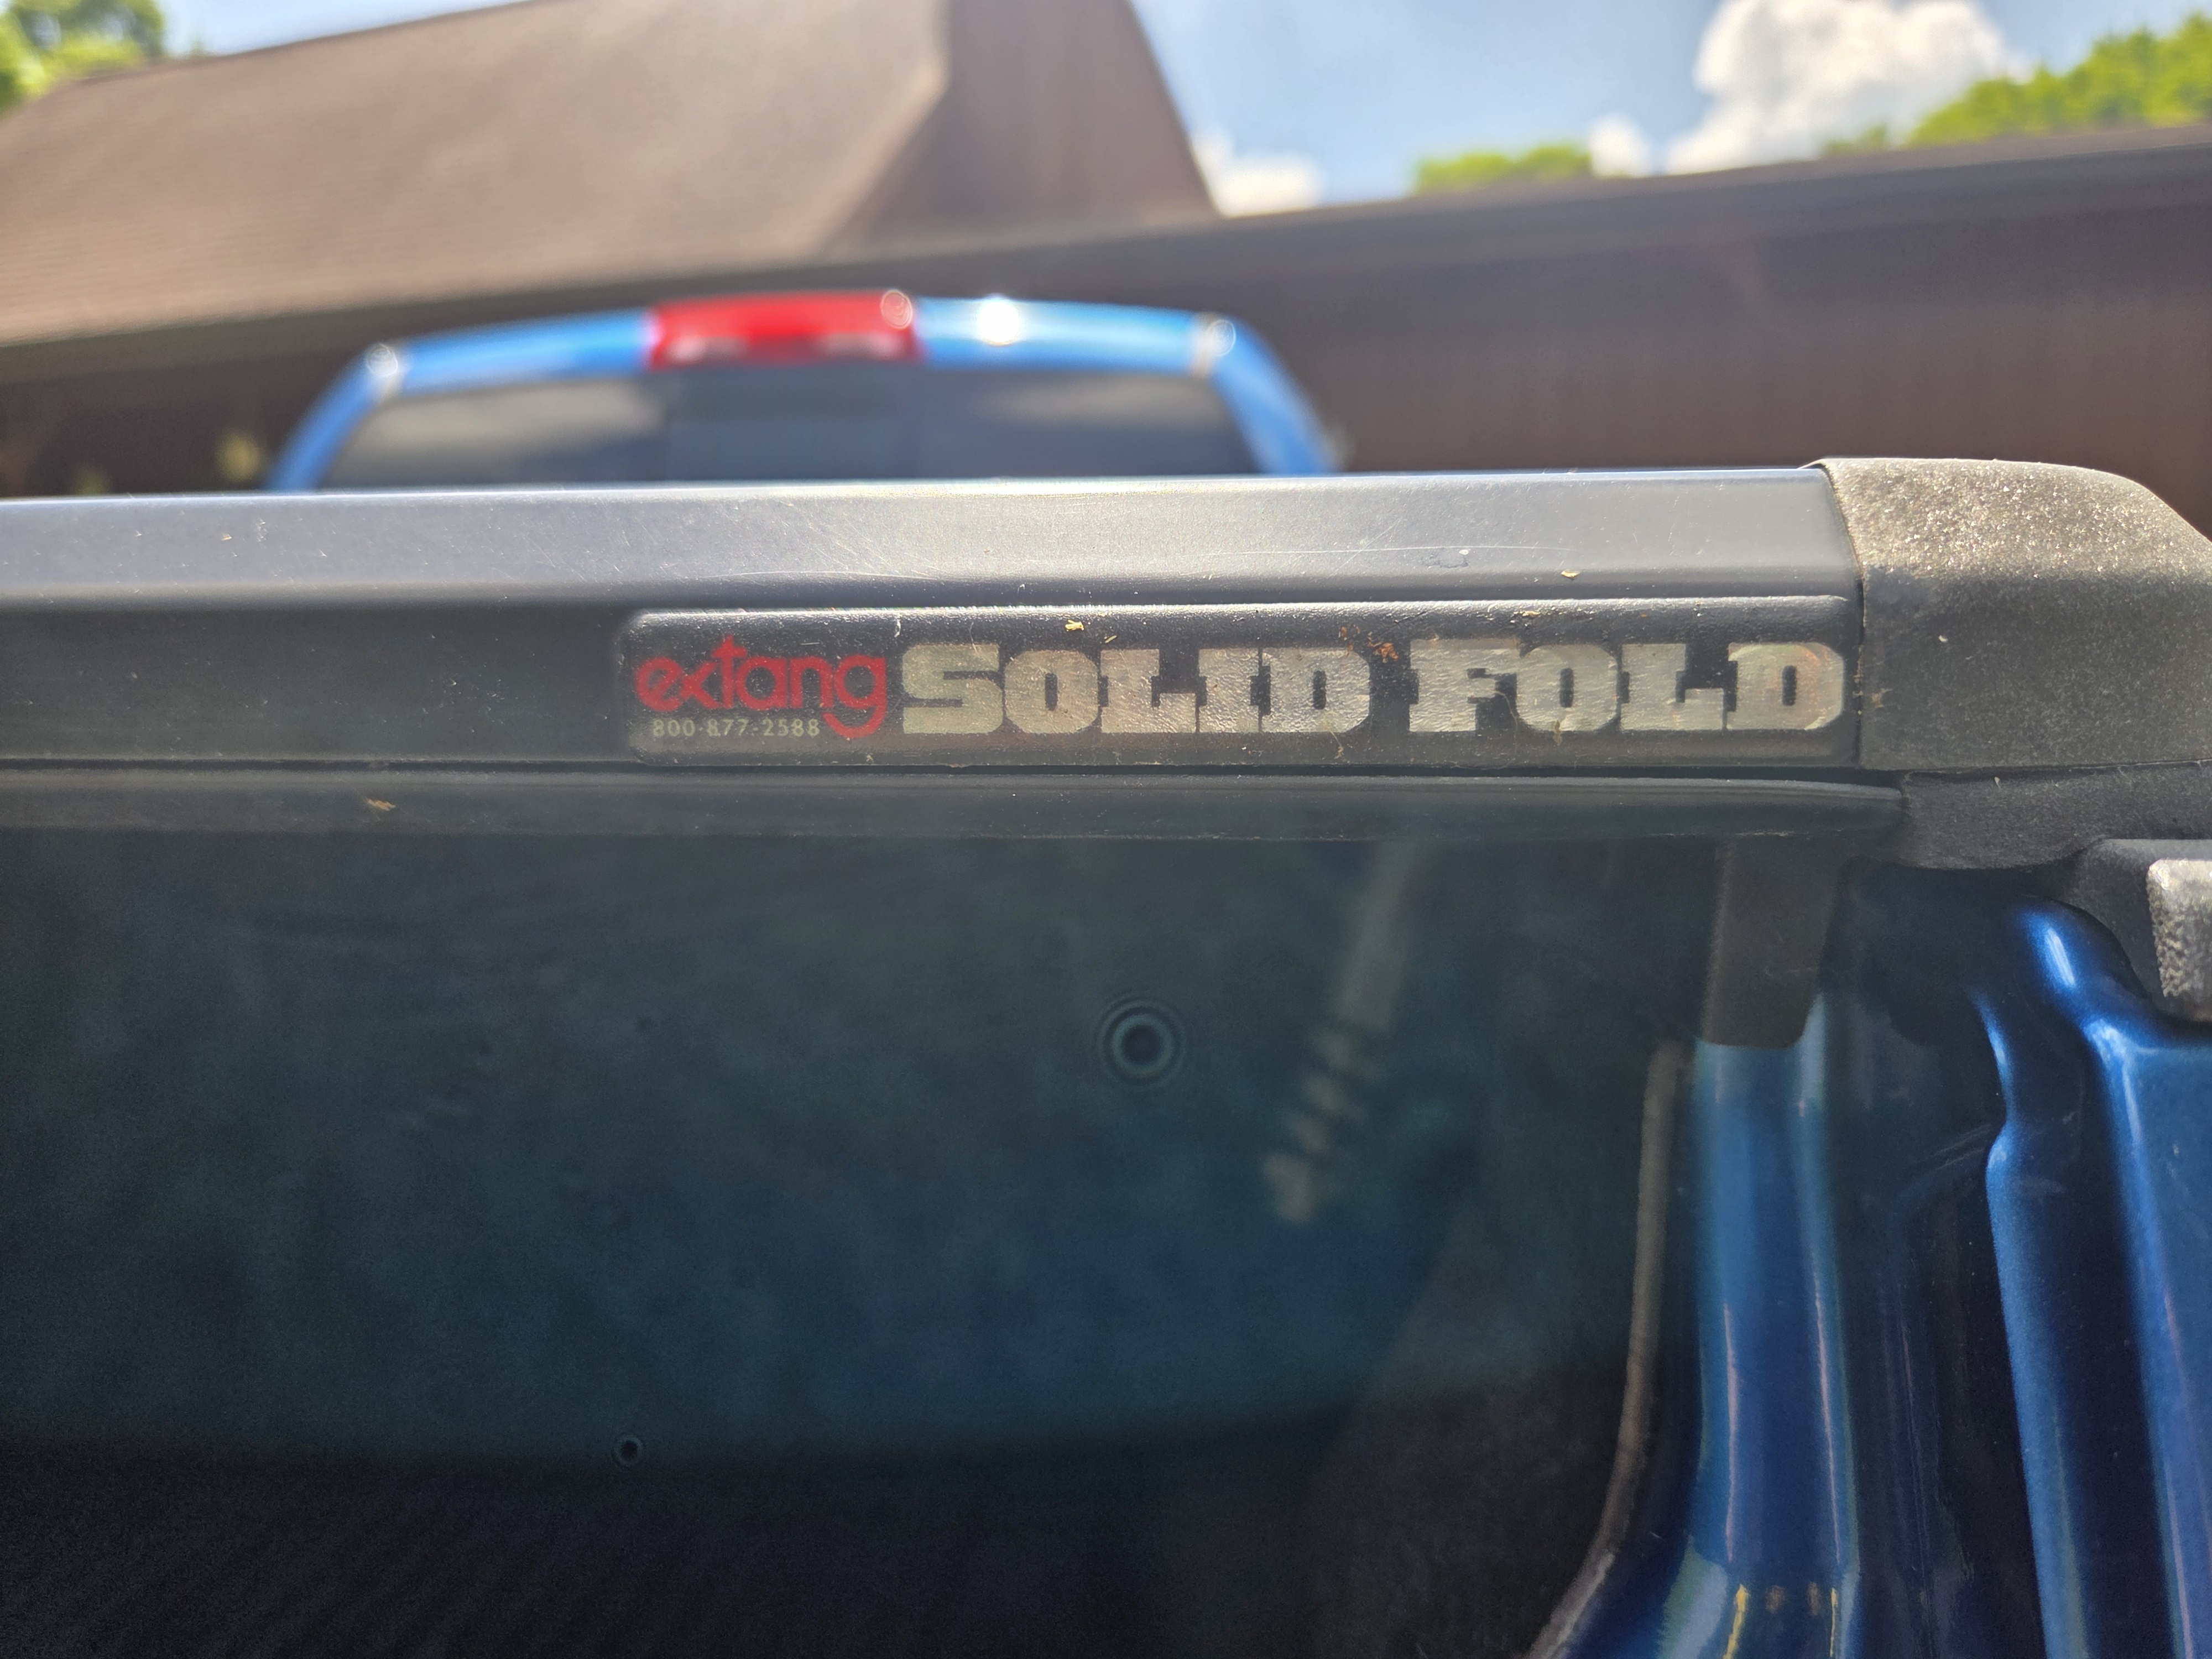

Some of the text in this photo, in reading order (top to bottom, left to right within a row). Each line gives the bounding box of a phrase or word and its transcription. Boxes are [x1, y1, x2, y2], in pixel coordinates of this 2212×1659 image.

[635, 634, 1845, 739] extang SOLID FOLD
